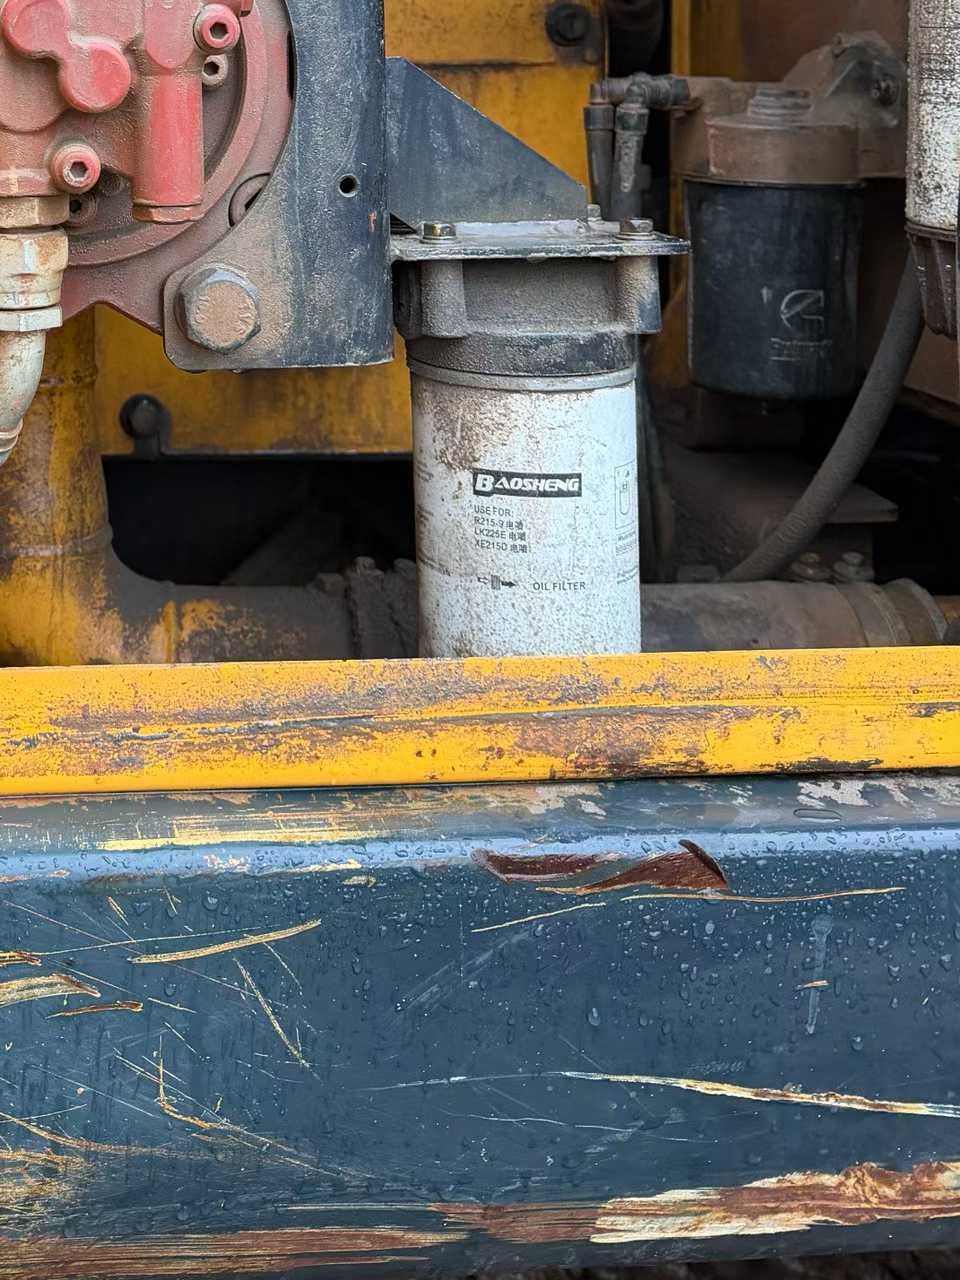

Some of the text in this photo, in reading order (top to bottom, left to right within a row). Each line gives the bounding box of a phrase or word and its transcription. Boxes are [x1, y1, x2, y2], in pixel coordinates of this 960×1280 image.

[474, 473, 580, 492] BAOSHENG
[474, 504, 491, 516] USE
[532, 581, 587, 592] OIL FILTER
